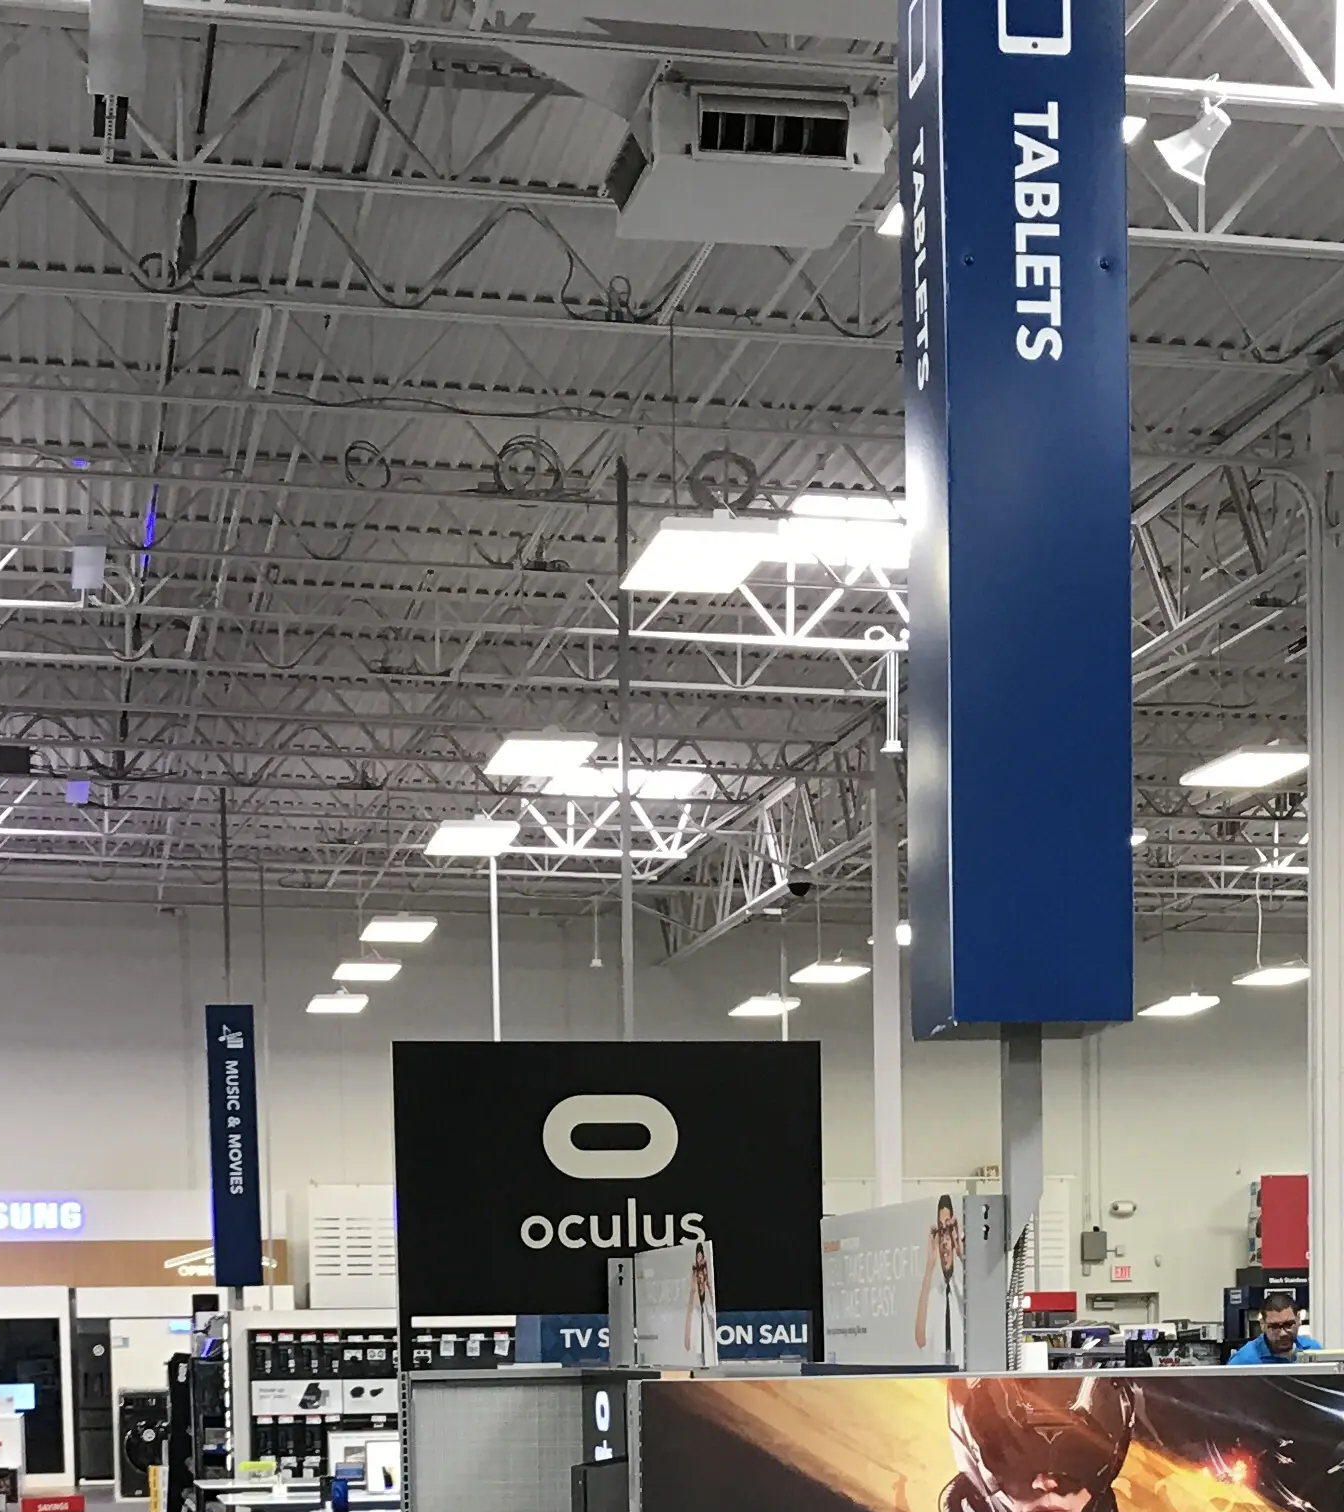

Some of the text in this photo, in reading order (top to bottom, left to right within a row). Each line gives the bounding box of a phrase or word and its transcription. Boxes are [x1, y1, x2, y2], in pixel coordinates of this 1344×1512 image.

[1013, 101, 1063, 361] TABLETS
[912, 126, 930, 391] TABLETS
[224, 1060, 244, 1195] MUSIC & MOVIES
[520, 1198, 706, 1250] oculus
[1114, 1265, 1131, 1279] EXIT
[560, 1328, 591, 1349] TV
[716, 1325, 754, 1345] ON
